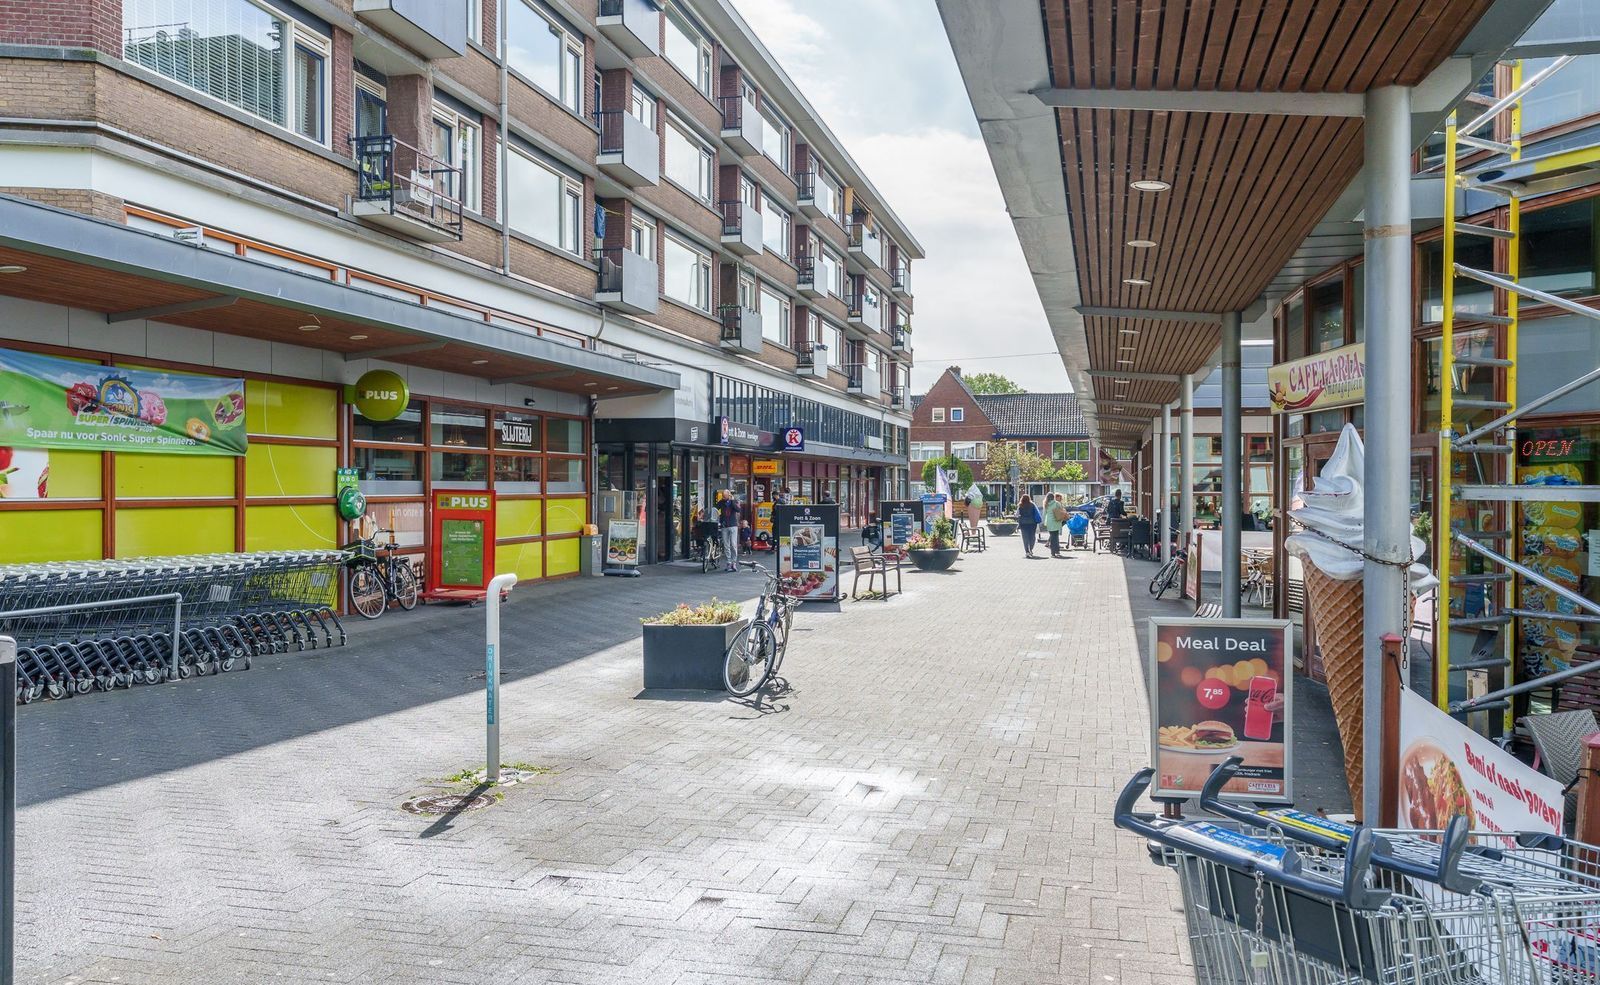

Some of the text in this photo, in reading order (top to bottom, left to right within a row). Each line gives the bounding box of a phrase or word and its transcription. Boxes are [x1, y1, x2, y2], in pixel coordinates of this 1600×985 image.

[1289, 351, 1361, 393] CAFETARIA
[366, 390, 398, 401] PLUS
[79, 413, 109, 424] SUPER
[27, 427, 58, 439] Spaar
[61, 430, 74, 438] nu
[76, 432, 99, 441] voor
[100, 432, 127, 443] Sonic
[129, 434, 155, 445] Super
[502, 424, 532, 443] SLIJTERIJ
[1522, 440, 1576, 456] OPEN
[451, 496, 488, 508] PLUS
[1177, 636, 1266, 652] Meal Deal
[1203, 688, 1223, 700] 7,85
[1464, 742, 1561, 836] Bami of nasi goreng
